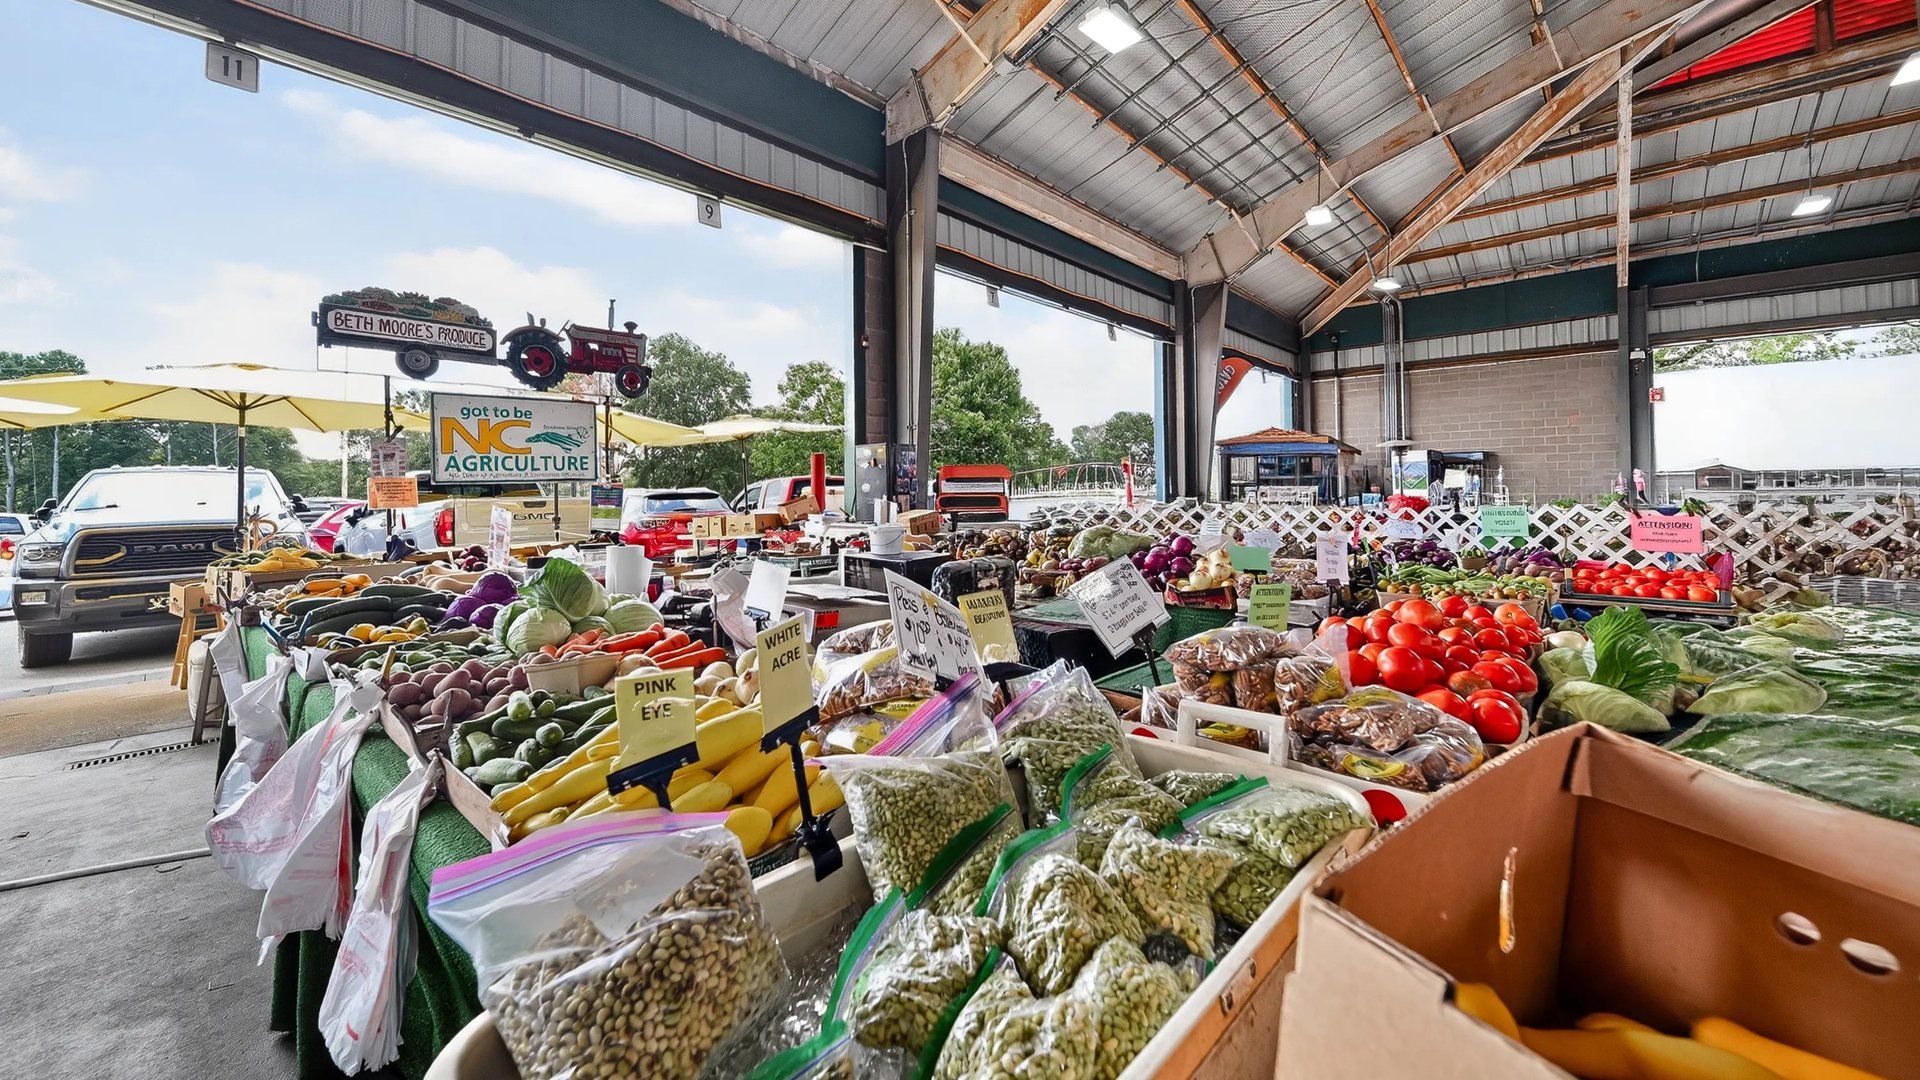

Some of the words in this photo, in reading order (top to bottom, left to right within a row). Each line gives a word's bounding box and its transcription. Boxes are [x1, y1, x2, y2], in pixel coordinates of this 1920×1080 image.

[222, 55, 242, 81] 11
[705, 204, 714, 219] 9
[334, 311, 374, 331] BETH
[378, 319, 434, 339] MOORE'S
[438, 326, 487, 347] PRODUCE
[460, 406, 489, 420] got
[493, 407, 510, 418] to
[513, 407, 533, 419] be
[440, 416, 532, 455] NC
[444, 454, 589, 473] AGRICULTURE
[513, 511, 556, 521] GMC
[133, 543, 206, 553] RAM
[764, 622, 801, 650] WHITE
[772, 646, 801, 672] ACRE
[634, 677, 677, 696] PINK
[641, 703, 672, 721] EYE
